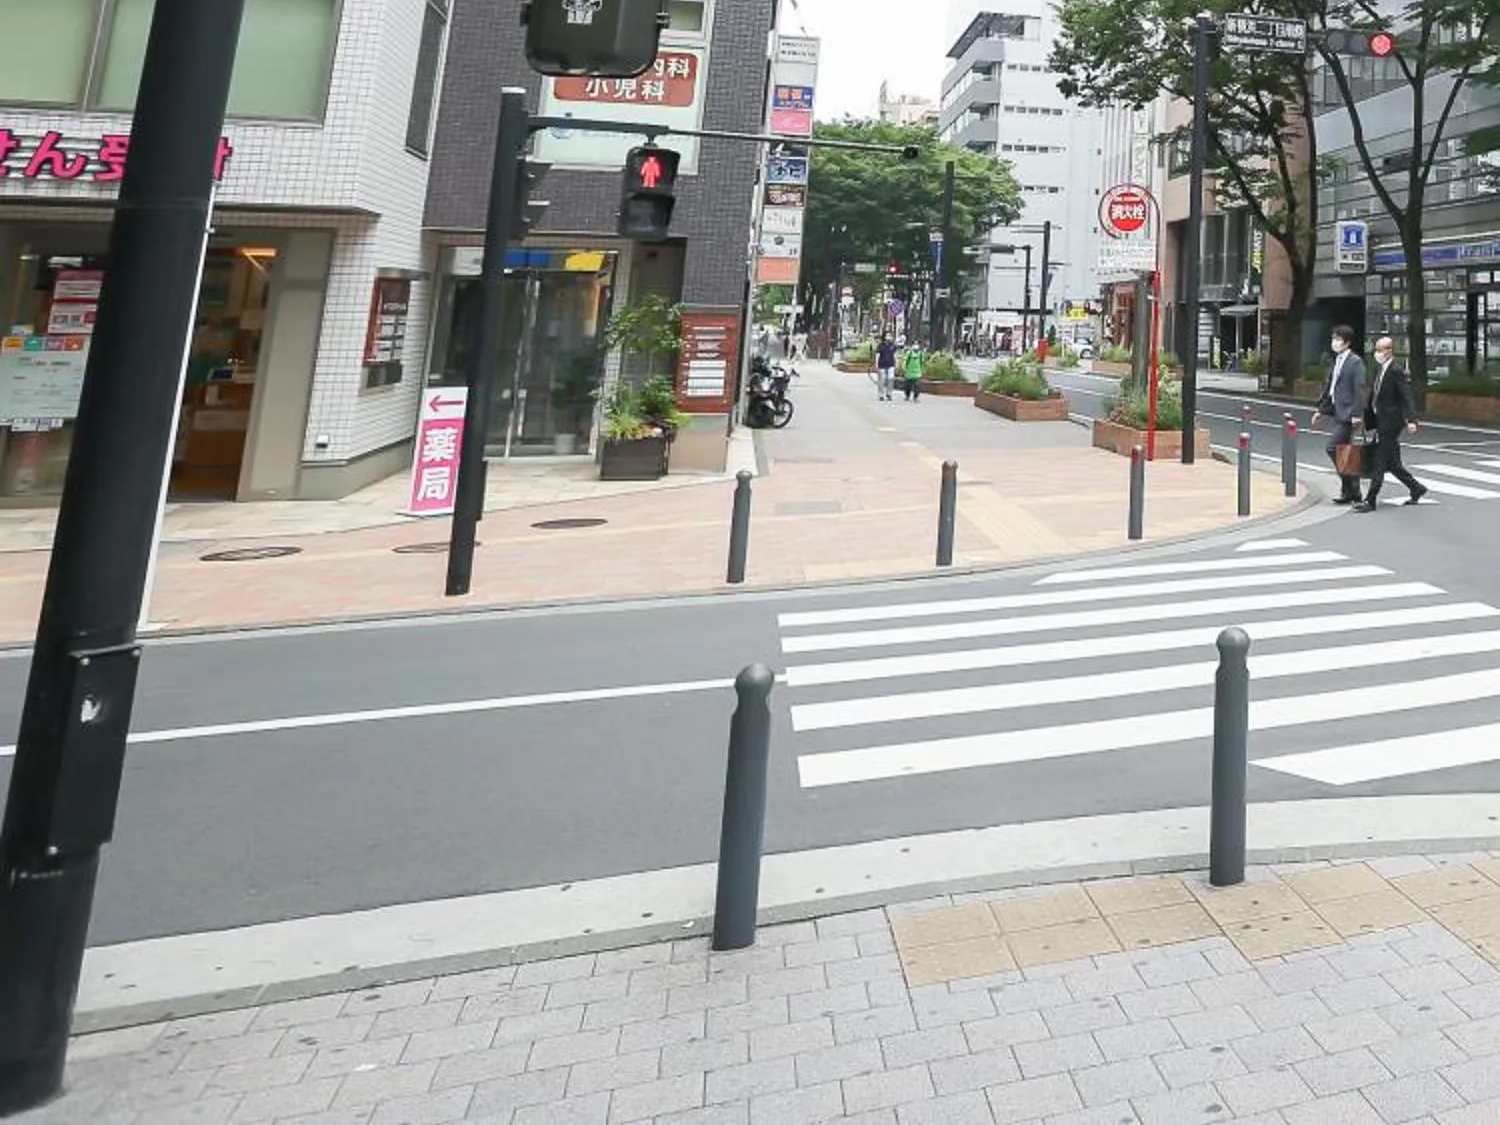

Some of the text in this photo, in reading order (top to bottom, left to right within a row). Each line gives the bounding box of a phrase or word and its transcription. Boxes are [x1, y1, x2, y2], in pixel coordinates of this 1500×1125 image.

[586, 78, 665, 101] 小児科
[1111, 204, 1145, 220] 消火栓
[416, 427, 458, 503] 薬局
